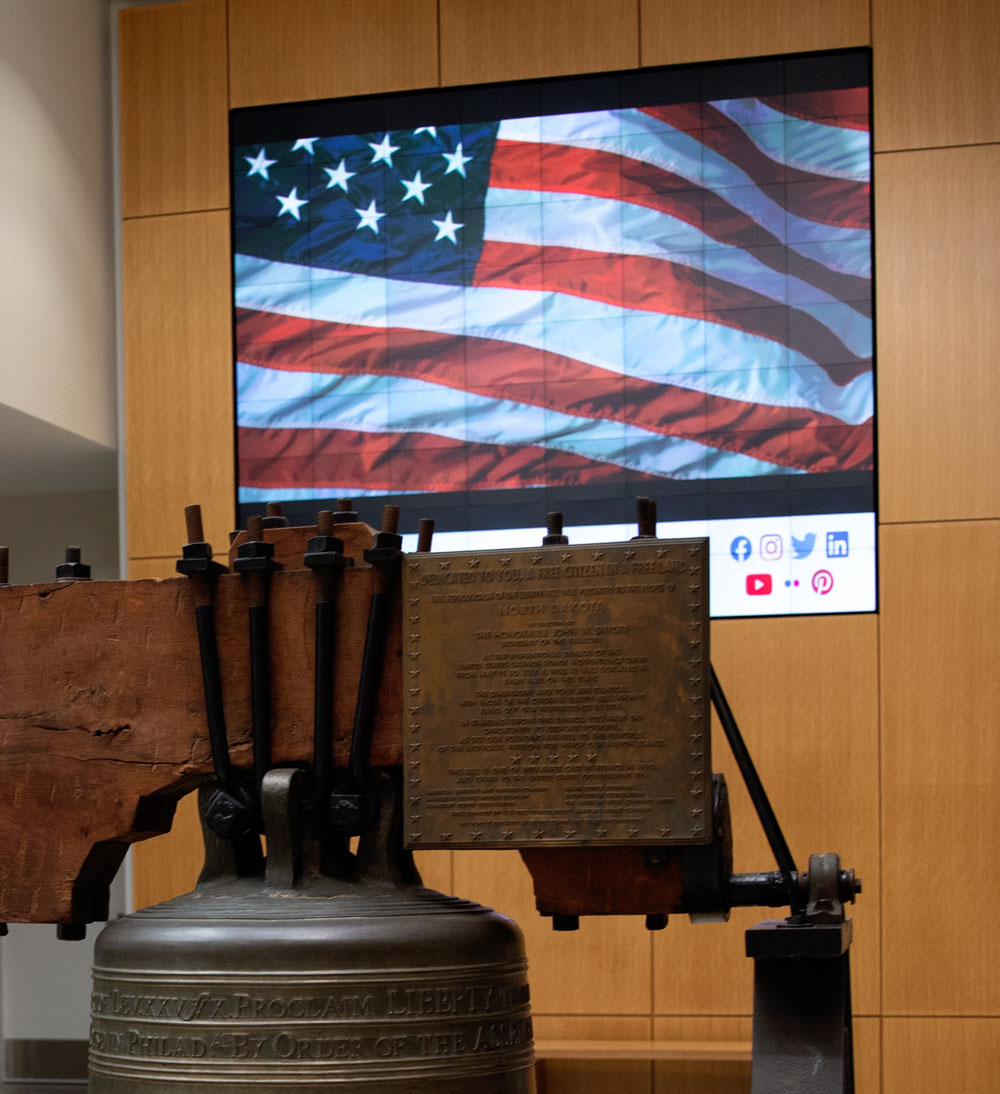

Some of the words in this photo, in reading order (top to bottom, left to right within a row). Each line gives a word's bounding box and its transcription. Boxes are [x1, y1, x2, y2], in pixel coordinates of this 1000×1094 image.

[421, 569, 476, 585] DEDICATED
[479, 568, 494, 583] TO
[537, 565, 560, 580] FREE
[564, 564, 602, 579] CITIZEN
[606, 563, 618, 577] IN
[632, 561, 655, 576] FREE
[658, 560, 687, 575] LAND
[498, 602, 545, 617] NORTH
[551, 599, 605, 615] DAKOTA
[386, 985, 495, 1017] LIBERTY
[271, 1031, 373, 1058] ORDER
[375, 1036, 409, 1057] OF
[416, 1032, 466, 1055] THE
